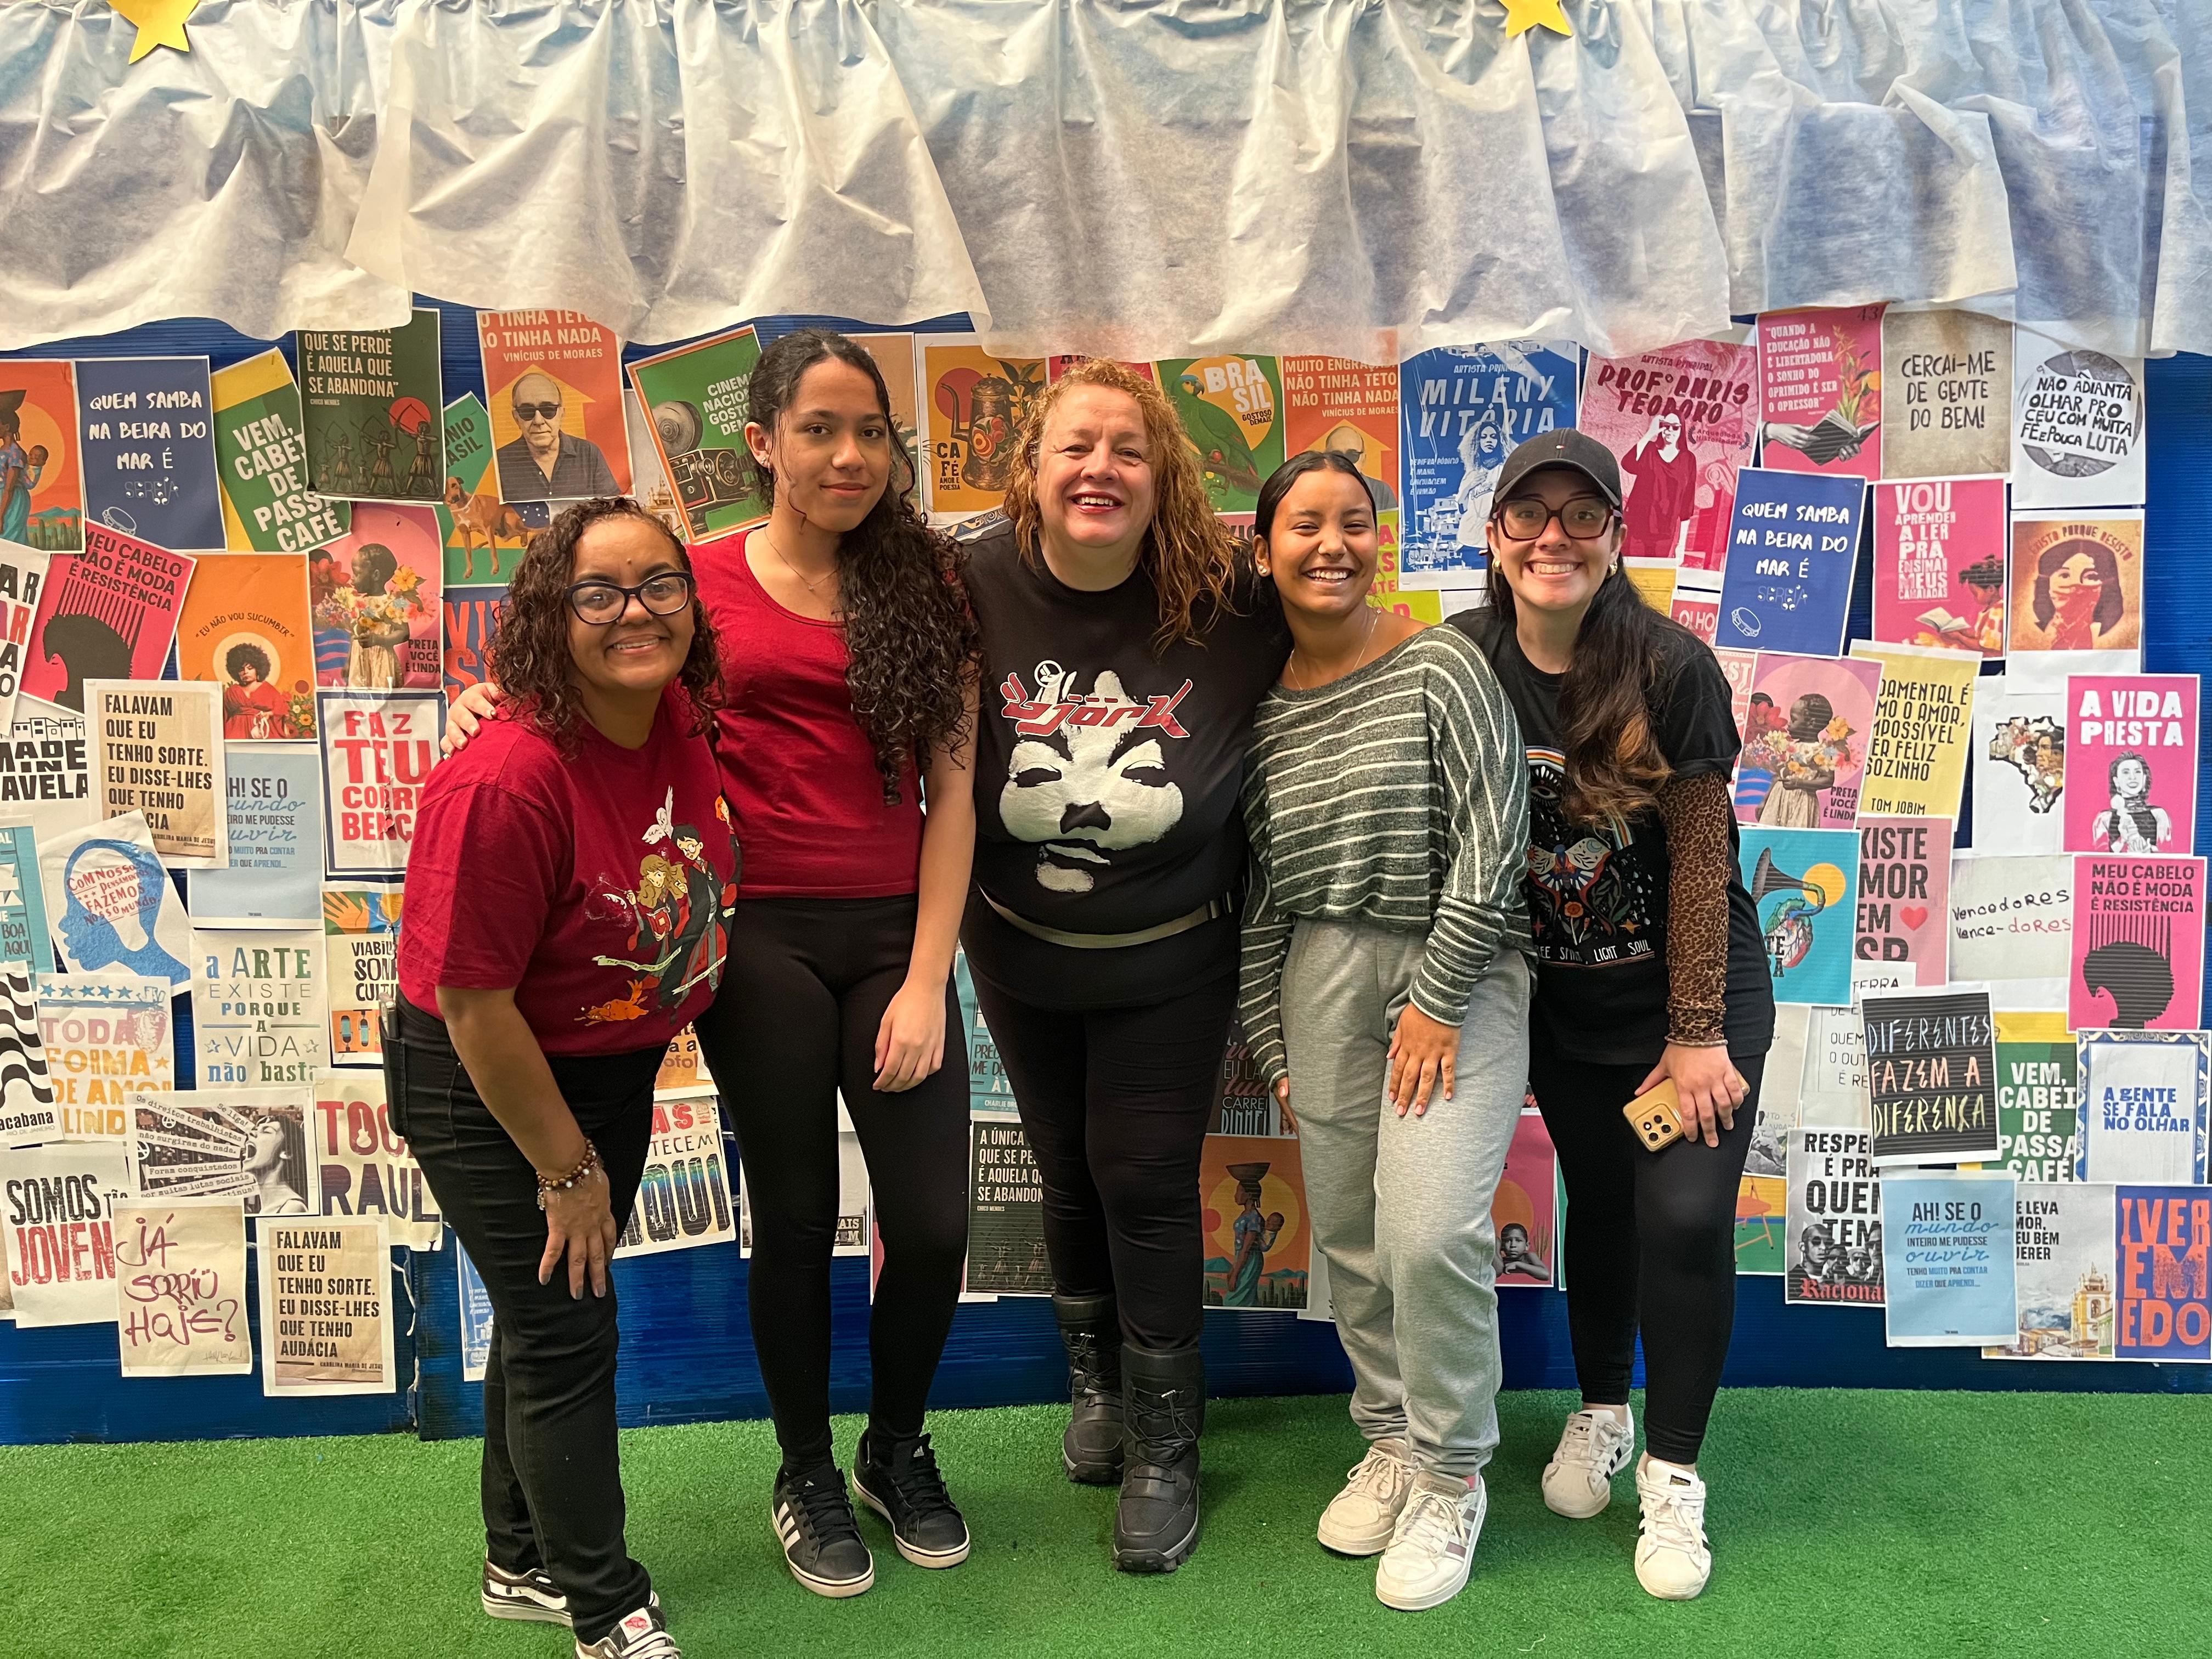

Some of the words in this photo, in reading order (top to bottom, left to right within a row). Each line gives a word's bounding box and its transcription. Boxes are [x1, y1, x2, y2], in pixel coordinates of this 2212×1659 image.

[503, 330, 553, 347] TINHA
[557, 328, 602, 344] NADA
[1810, 323, 1816, 334] A
[304, 334, 329, 351] QUE
[332, 335, 347, 351] SE
[352, 337, 392, 354] PERDE
[1767, 337, 1810, 353] EDUCAÇÃO
[1813, 335, 1830, 349] NÃO
[504, 350, 545, 362] VINÍCIUS
[549, 350, 560, 359] DE
[563, 348, 602, 359] MORAES
[1768, 355, 1773, 368] É
[1776, 351, 1833, 366] LIBERTADORA
[307, 354, 314, 372] É
[319, 356, 363, 375] AQUELA
[368, 358, 392, 376] QUE
[1285, 359, 1324, 373] MUITO
[1768, 371, 1774, 383] O
[1776, 369, 1808, 382] SONHO
[1811, 366, 1819, 379] DO
[309, 377, 325, 394] SE
[1286, 374, 1314, 390] NÃO
[1319, 373, 1361, 388] TINHA
[1364, 372, 1397, 386] TETO
[1421, 375, 1554, 405] MILENY
[1768, 383, 1810, 399] OPRIMIDO
[1813, 380, 1819, 394] É
[1821, 382, 1837, 393] SER
[90, 392, 137, 410] QUEM
[147, 391, 202, 409] SAMBA
[1293, 391, 1318, 407] NÃO
[1322, 391, 1361, 405] TINHA
[1365, 389, 1400, 404] NADA
[1907, 383, 1928, 404] DE
[1939, 379, 1989, 402] GENTE
[1242, 409, 1272, 421] GOSTOSO
[2029, 394, 2082, 412] OLHAR
[2089, 399, 2122, 418] PRO
[1910, 409, 1930, 431] DO
[1941, 405, 1985, 430] BEM!
[89, 423, 110, 439] NA
[120, 422, 171, 439] BEIRA
[180, 421, 206, 438] DO
[233, 414, 293, 451] VEM,
[117, 453, 153, 470] MAR
[163, 449, 173, 469] É
[267, 467, 302, 497] DE
[1894, 482, 1951, 514] VOU
[1742, 502, 1786, 520] QUEM
[1796, 504, 1849, 524] SAMBA
[277, 508, 342, 552] CAFÉ
[1899, 524, 1914, 541] A
[1920, 523, 1949, 540] LER
[1736, 529, 1757, 545] NA
[1765, 530, 1812, 550] BEIRA
[1821, 535, 1848, 553] DO
[1899, 541, 1944, 559] PRA
[2030, 530, 2059, 555] EXISTO
[2062, 524, 2099, 538] PORQUE
[2100, 531, 2132, 561] RESISTO
[1756, 558, 1790, 576] MAR
[1798, 558, 1809, 578] É
[1898, 572, 1948, 590] MEUS
[210, 615, 226, 629] NÃO
[228, 612, 245, 622] VOU
[409, 639, 439, 650] PRETA
[410, 651, 439, 660] VOCÊ
[406, 661, 410, 672] É
[413, 663, 441, 673] LINDA
[105, 695, 172, 716] FALAVAM
[2079, 690, 2102, 718] A
[2112, 690, 2183, 718] VIDA
[106, 719, 133, 738] QUE
[139, 721, 155, 740] EU
[344, 710, 412, 738] FAZ
[2080, 721, 2183, 746] PRESTA
[107, 743, 153, 763] TENHO
[159, 747, 208, 767] SORTE.
[1895, 740, 1937, 763] FELIZ
[108, 766, 124, 783] EU
[131, 768, 212, 790] DISSE-LHES
[251, 778, 271, 797] SE
[277, 778, 287, 798] O
[1830, 786, 1857, 798] PRETA
[109, 788, 134, 805] QUE
[140, 791, 184, 810] TENHO
[1830, 798, 1856, 809] VOCÊ
[1871, 798, 1892, 812] TOM
[1895, 800, 1926, 815] JOBIM
[246, 815, 257, 825] ME
[259, 816, 295, 826] PUDESSE
[1823, 807, 1829, 818] É
[1830, 809, 1856, 821] LINDA
[2092, 863, 2128, 879] MEU
[2132, 865, 2194, 880] CABELO
[2092, 879, 2129, 895] NÃO
[2132, 879, 2142, 895] É
[2145, 882, 2193, 898] MODA
[1594, 946, 1617, 962] LIGHT
[1628, 939, 1651, 955] SOUL
[210, 983, 311, 998] EXISTE
[222, 1002, 301, 1017] PORQUE
[40, 1018, 138, 1045] TODA
[1867, 1015, 1990, 1056] DIFERENTES
[225, 1036, 299, 1057] VIDA
[46, 1048, 150, 1076] FORMA
[208, 1062, 246, 1082] não
[1871, 1057, 1949, 1097] FAZEM
[1964, 1057, 1981, 1087] A
[2011, 1063, 2066, 1086] VEM,
[2103, 1087, 2114, 1101] A
[2103, 1102, 2119, 1116] SE
[2125, 1102, 2170, 1118] FALA
[2023, 1110, 2051, 1133] DE
[2104, 1117, 2129, 1130] NO
[2135, 1118, 2190, 1132] OLHAR
[980, 1130, 989, 1146] A
[991, 1127, 1025, 1146] ÚNICA
[979, 1149, 1001, 1165] QUE
[1003, 1149, 1018, 1165] SE
[178, 1163, 238, 1173] conquistados
[978, 1167, 986, 1183] É
[989, 1168, 1029, 1184] AQUELA
[7, 1174, 101, 1224] SOMOS
[320, 1163, 441, 1222] RAUL
[977, 1187, 990, 1202] SE
[1912, 1203, 1939, 1222] AH!
[1945, 1203, 1965, 1221] SE
[1970, 1203, 1981, 1222] O
[2026, 1201, 2059, 1215] LEVA
[276, 1231, 341, 1249] FALAVAM
[1908, 1237, 1937, 1246] INTEIRO
[1939, 1237, 1951, 1246] ME
[1953, 1237, 1988, 1246] PUDESSE
[2034, 1232, 2059, 1245] BEM
[277, 1255, 303, 1272] QUE
[309, 1255, 325, 1272] EU
[1929, 1267, 1948, 1275] MUITO
[1962, 1266, 1988, 1274] CONTAR
[279, 1277, 323, 1294] TENHO
[328, 1278, 375, 1295] SORTE.
[280, 1299, 295, 1315] EU
[301, 1300, 379, 1317] DISSE-LHES
[280, 1320, 304, 1336] QUE
[309, 1321, 352, 1338] TENHO
[280, 1338, 337, 1357] AUDÁCIA
